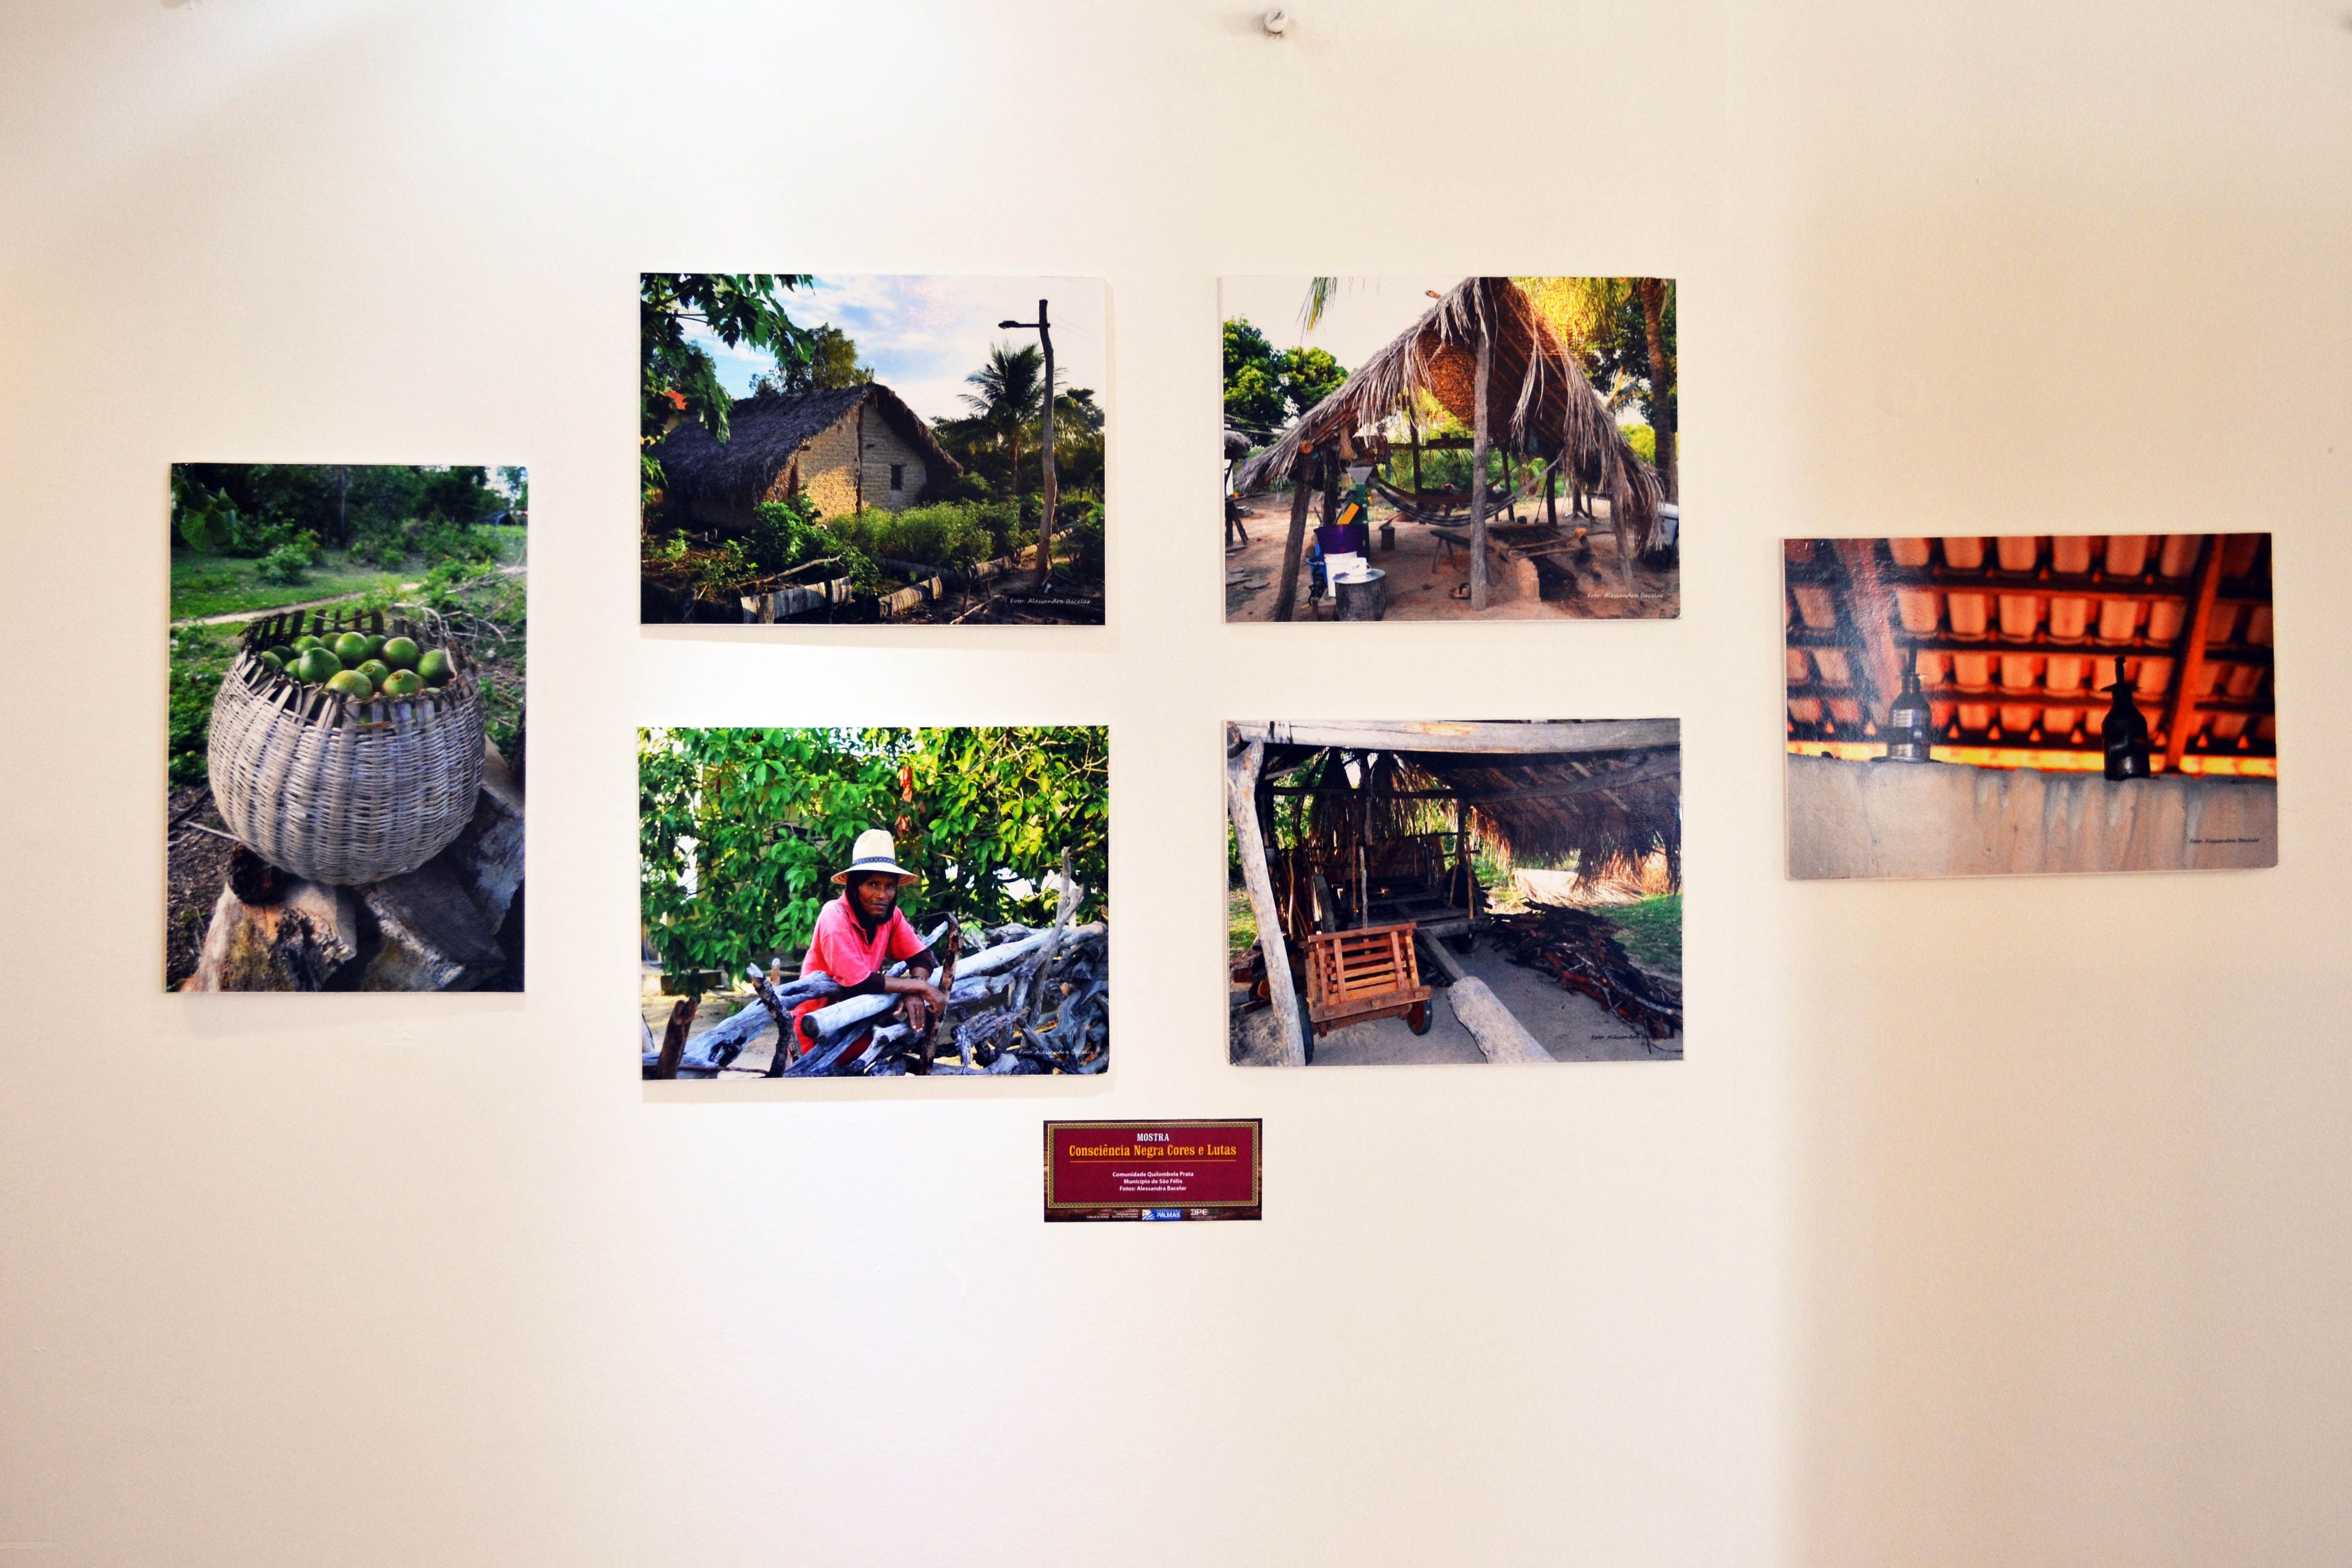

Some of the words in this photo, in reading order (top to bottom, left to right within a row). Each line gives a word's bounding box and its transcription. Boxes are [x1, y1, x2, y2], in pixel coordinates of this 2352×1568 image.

[1137, 1133, 1169, 1142] MOSTRA
[1069, 1143, 1131, 1157] Consciência
[1134, 1144, 1164, 1159] Negra
[1167, 1144, 1195, 1156] Cores
[1198, 1146, 1204, 1156] e
[1207, 1144, 1237, 1156] Lutas
